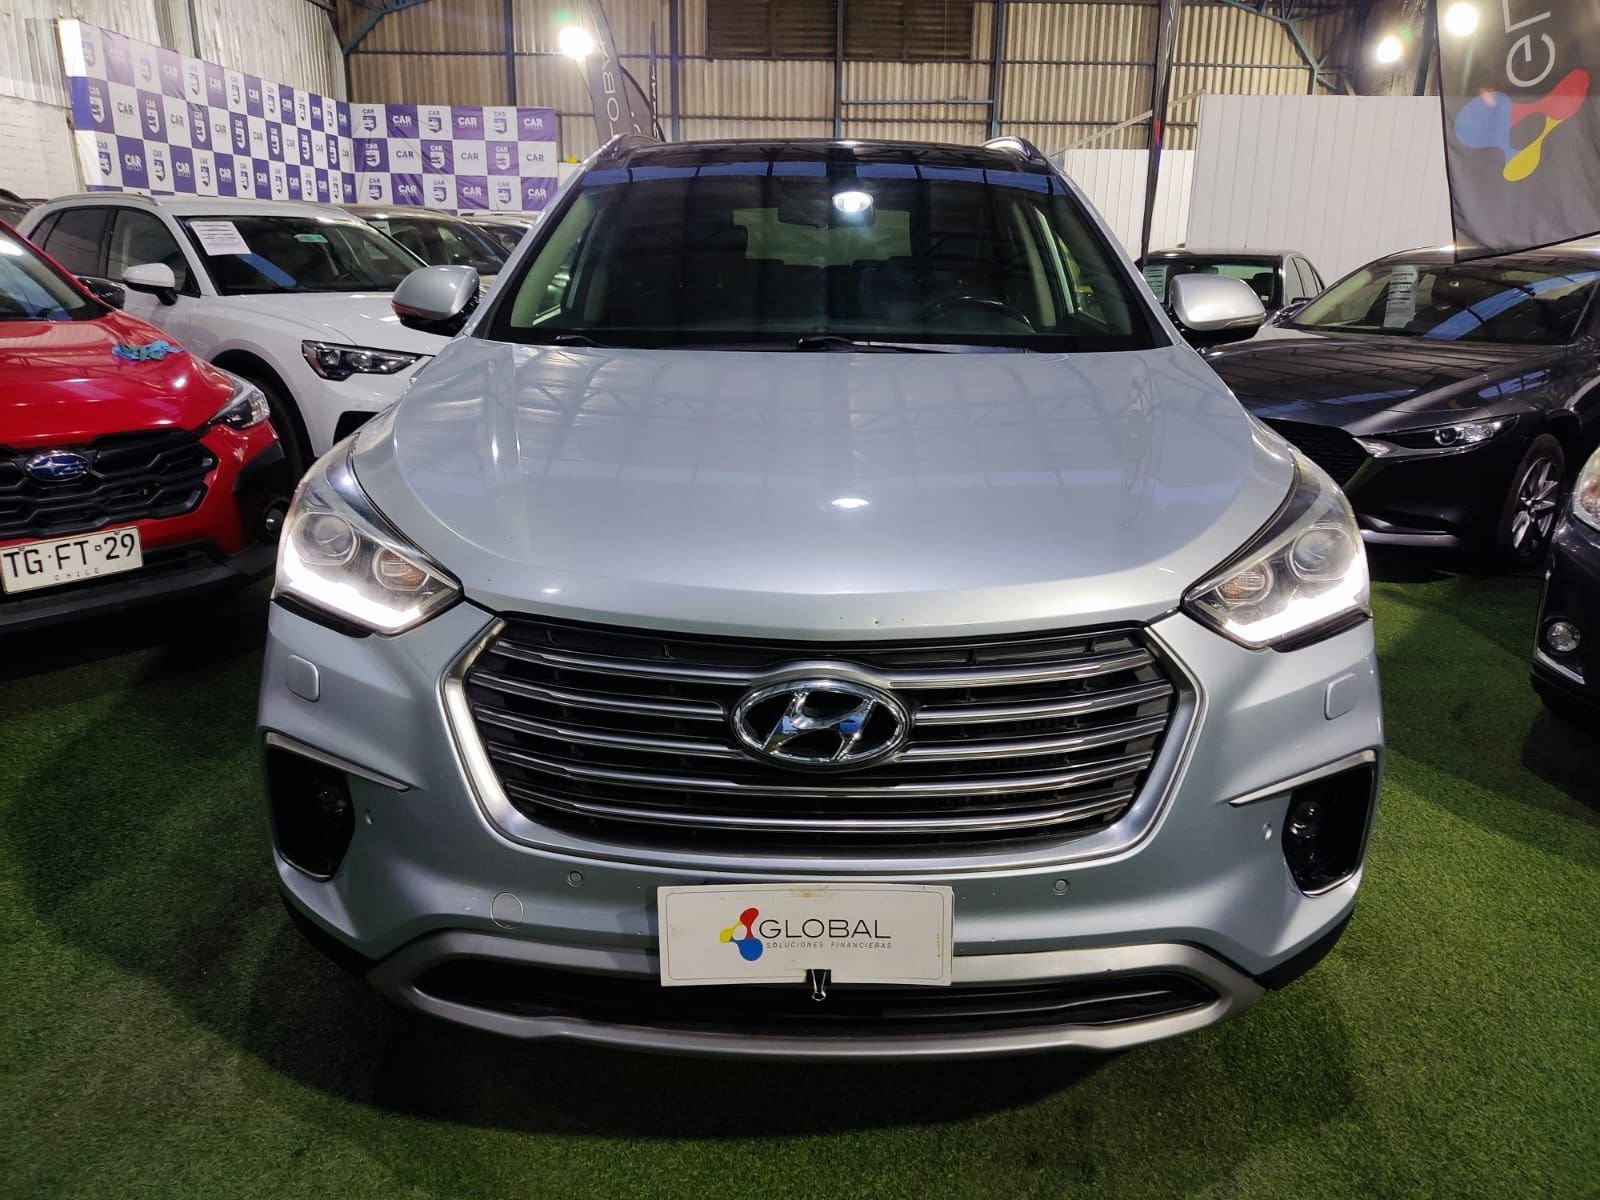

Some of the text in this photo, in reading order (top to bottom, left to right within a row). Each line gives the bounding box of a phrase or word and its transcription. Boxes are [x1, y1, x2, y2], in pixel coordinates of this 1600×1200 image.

[117, 102, 134, 115] CAR
[392, 115, 412, 125] CAR
[458, 116, 478, 126] CAR
[523, 118, 543, 128] CAR
[396, 150, 414, 159] CAR
[461, 152, 479, 160] CAR
[526, 153, 545, 162] CAR
[398, 185, 417, 194] CAR
[463, 186, 482, 196] CAR
[527, 188, 547, 198] CAR
[759, 918, 892, 939] GLOBAL
[766, 941, 893, 949] SOLUCIONES FINANCIERAS
